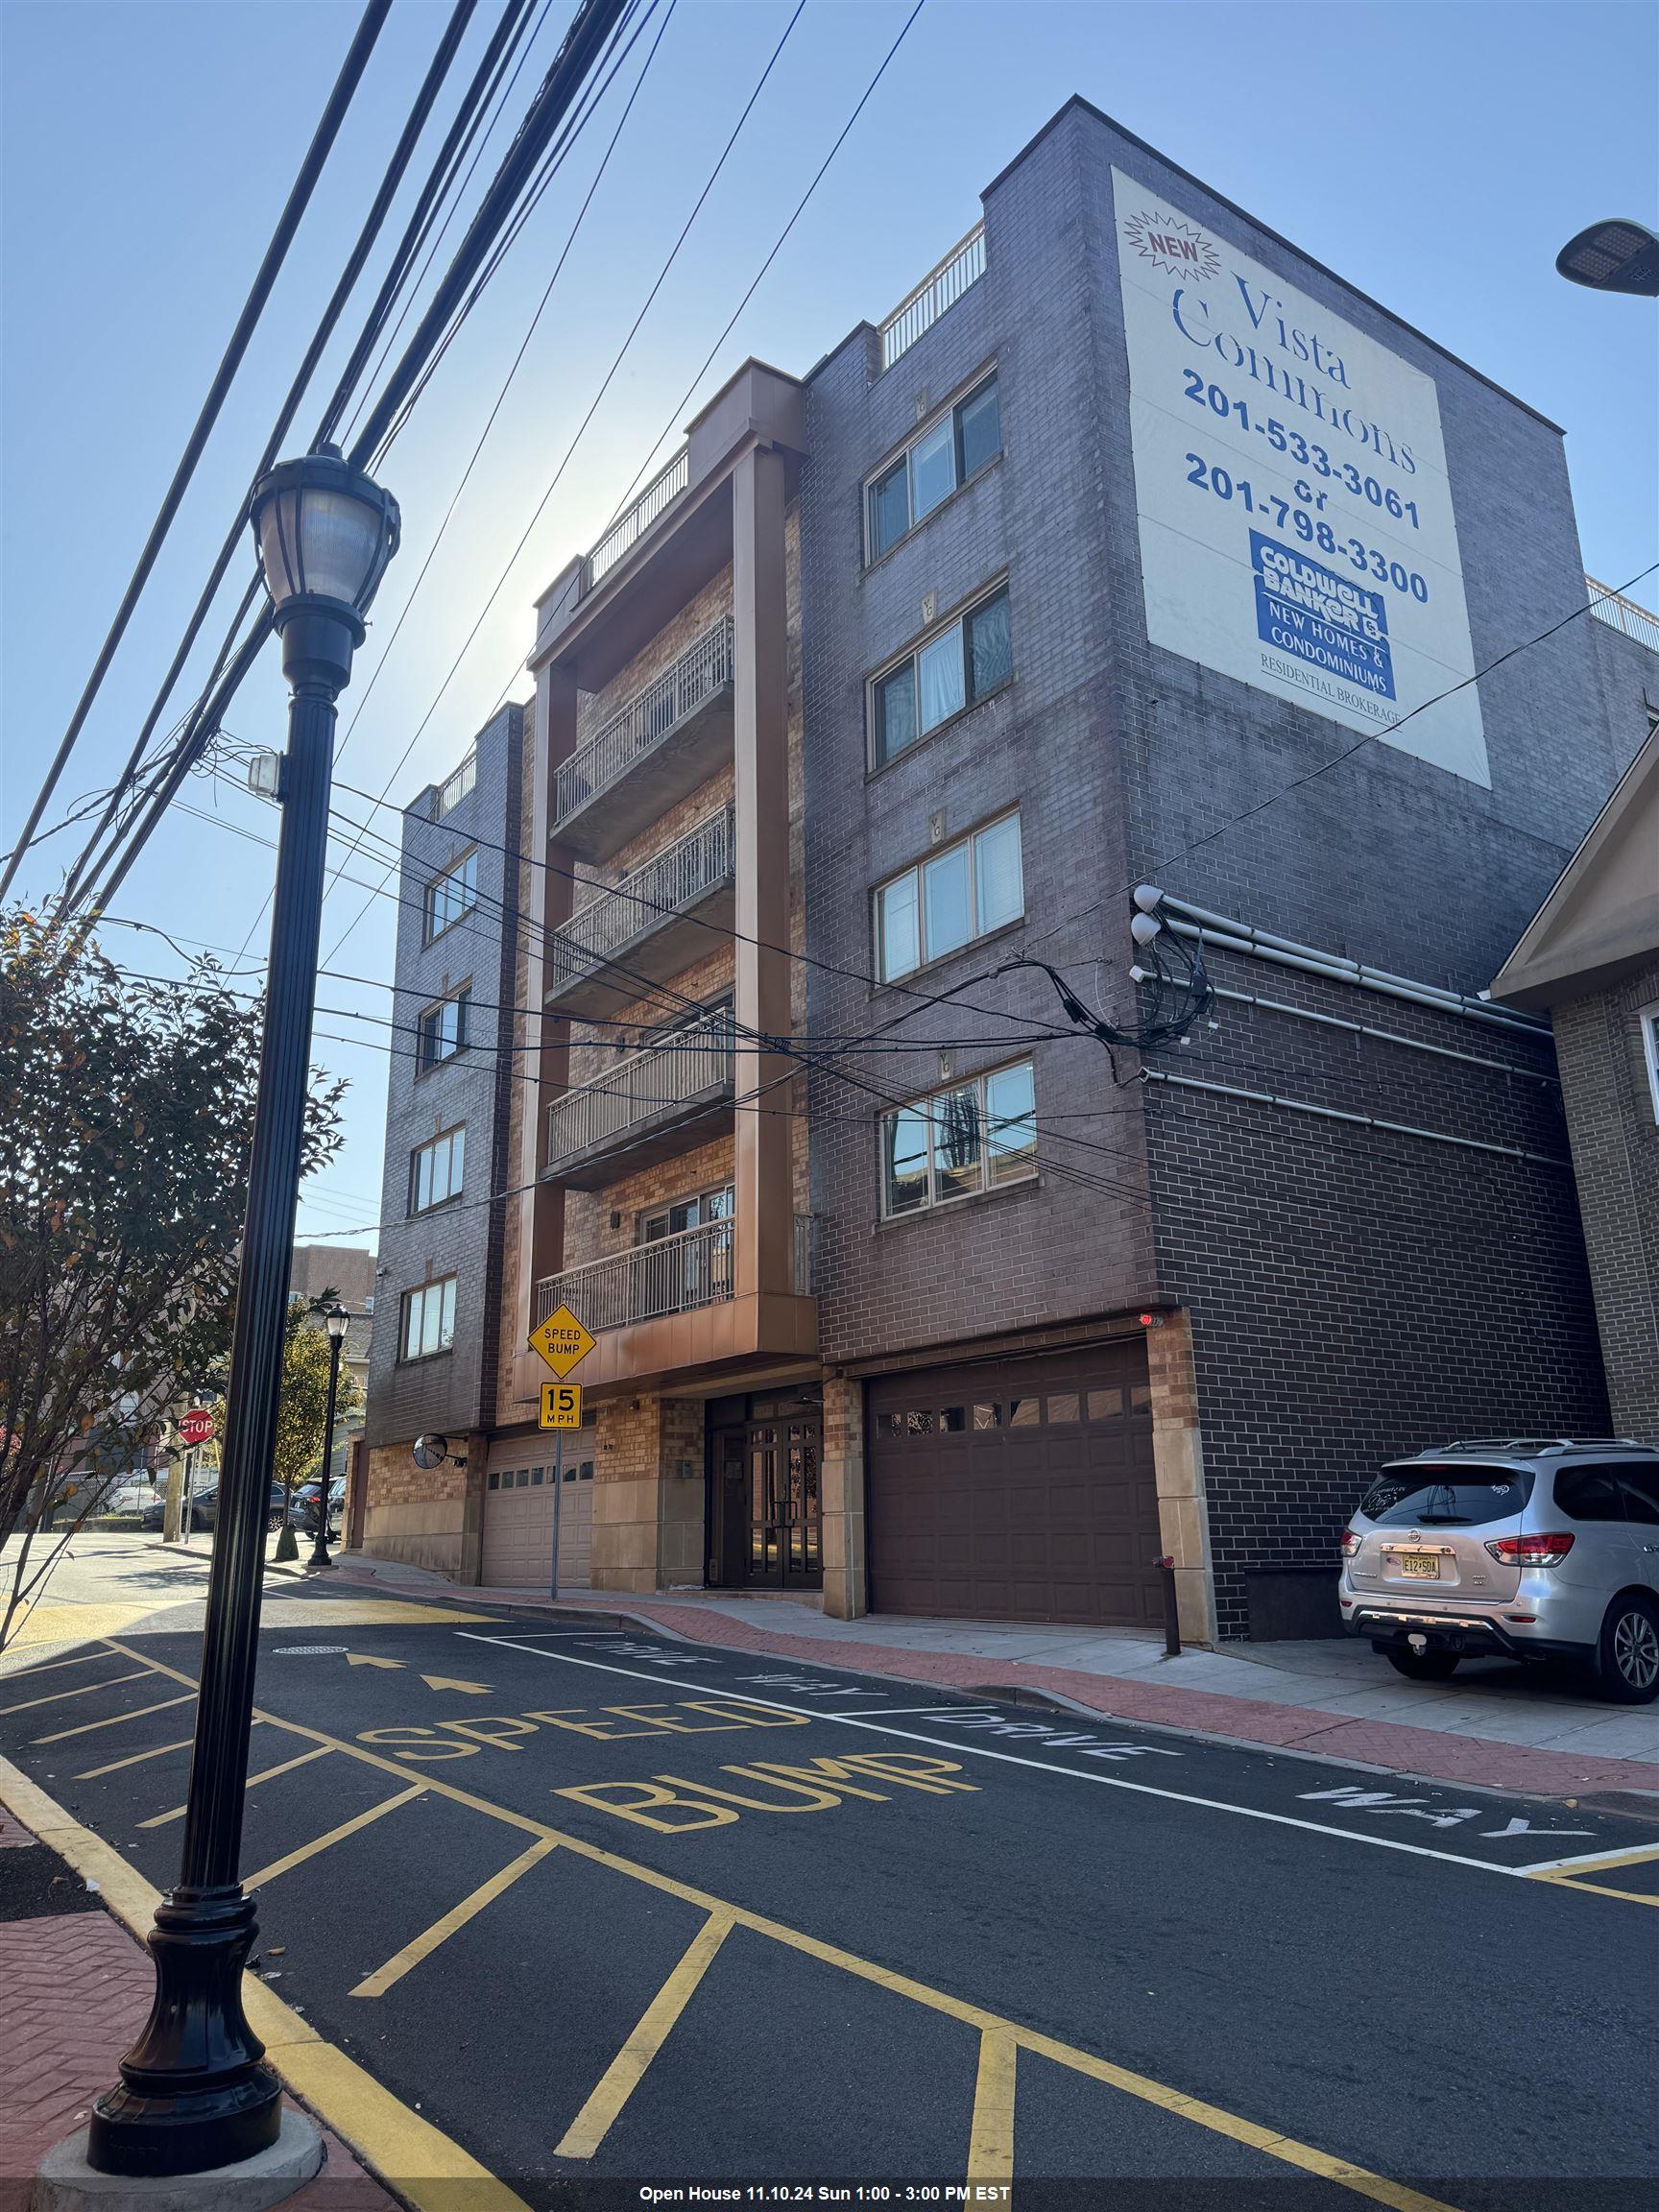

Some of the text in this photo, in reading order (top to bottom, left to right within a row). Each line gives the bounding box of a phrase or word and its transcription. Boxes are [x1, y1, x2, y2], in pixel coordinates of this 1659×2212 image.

[1147, 231, 1199, 262] NEW
[1230, 270, 1351, 389] Vista
[1172, 289, 1416, 474] Commons
[1183, 369, 1419, 529] 201-533-3061
[1294, 480, 1328, 512] or
[1185, 452, 1429, 603] 201-798-3300
[1261, 546, 1379, 620] COLDWELL
[1262, 566, 1359, 633] BANKER
[1269, 601, 1305, 631] NEW
[1311, 621, 1368, 661] HOMES
[1373, 647, 1383, 669] &
[1271, 627, 1387, 692] CONDOMINIUMS
[1261, 653, 1402, 727] RESIDENTIAL BROKERAGE
[544, 1328, 581, 1340] SPEED
[548, 1342, 580, 1355] BUMP
[181, 1420, 213, 1433] STOP
[546, 1414, 574, 1424] MPH
[547, 1388, 574, 1411] 15
[733, 1673, 890, 1697] WAY
[355, 1700, 812, 1761] SPEED
[921, 1713, 1187, 1761] DRIVE
[549, 1752, 984, 1834] BUMP
[1296, 1786, 1599, 1839] WAY
